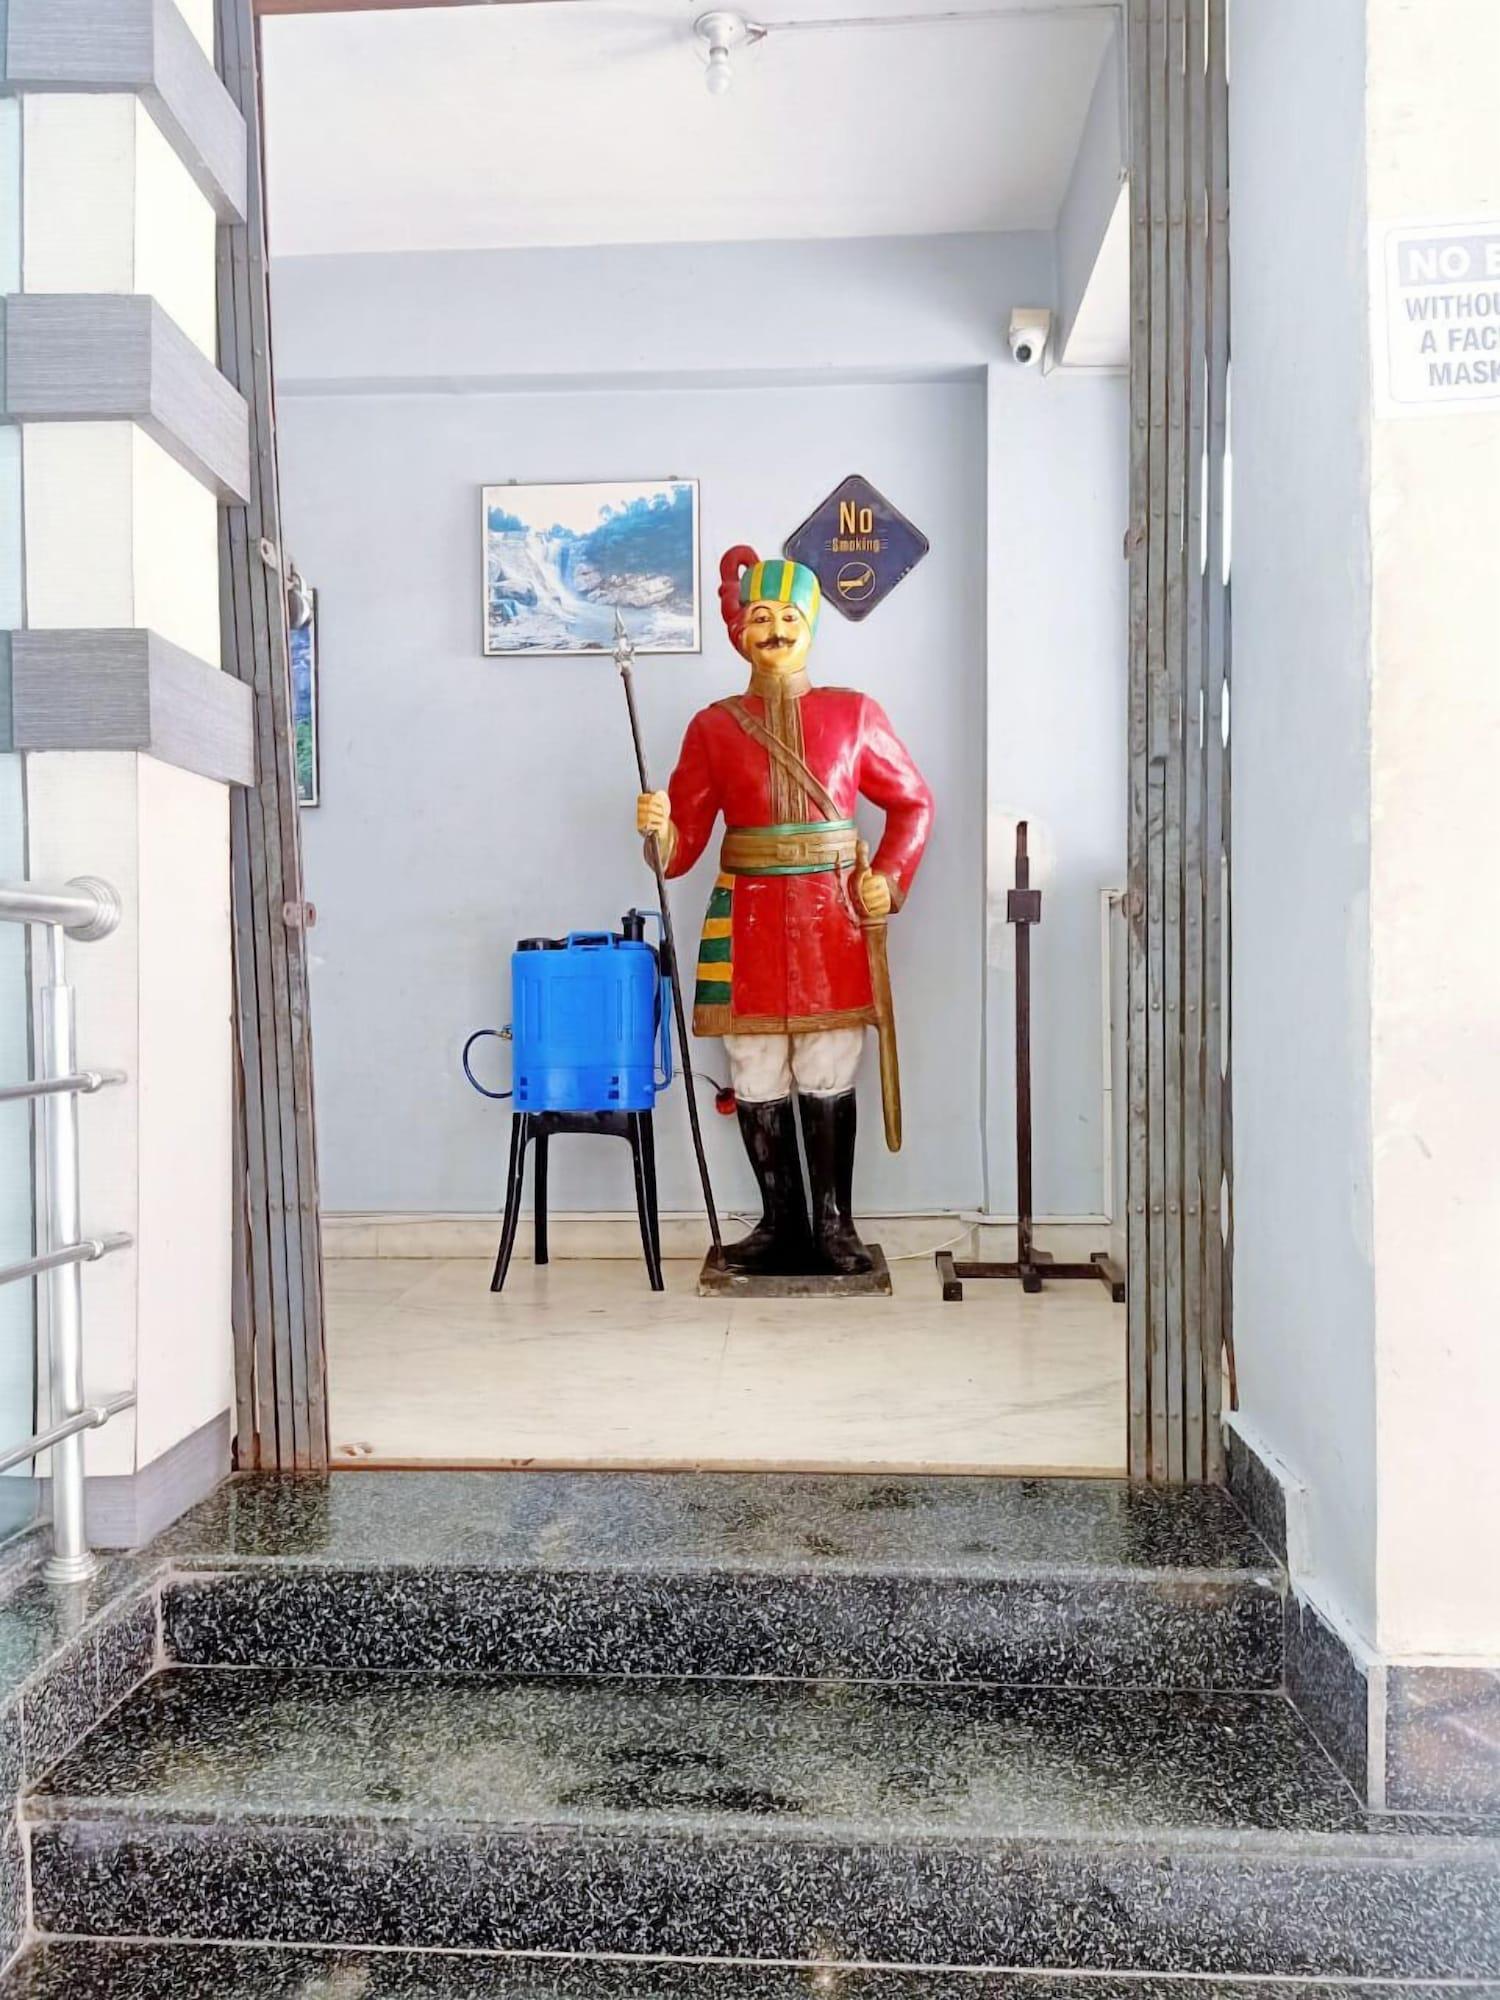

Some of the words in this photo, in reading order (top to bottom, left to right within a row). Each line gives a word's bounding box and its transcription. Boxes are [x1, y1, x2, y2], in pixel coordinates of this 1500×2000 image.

[1408, 246, 1471, 280] NO
[1420, 329, 1437, 354] A
[1448, 326, 1500, 352] FAC
[840, 501, 873, 534] No
[832, 537, 880, 553] Smoking
